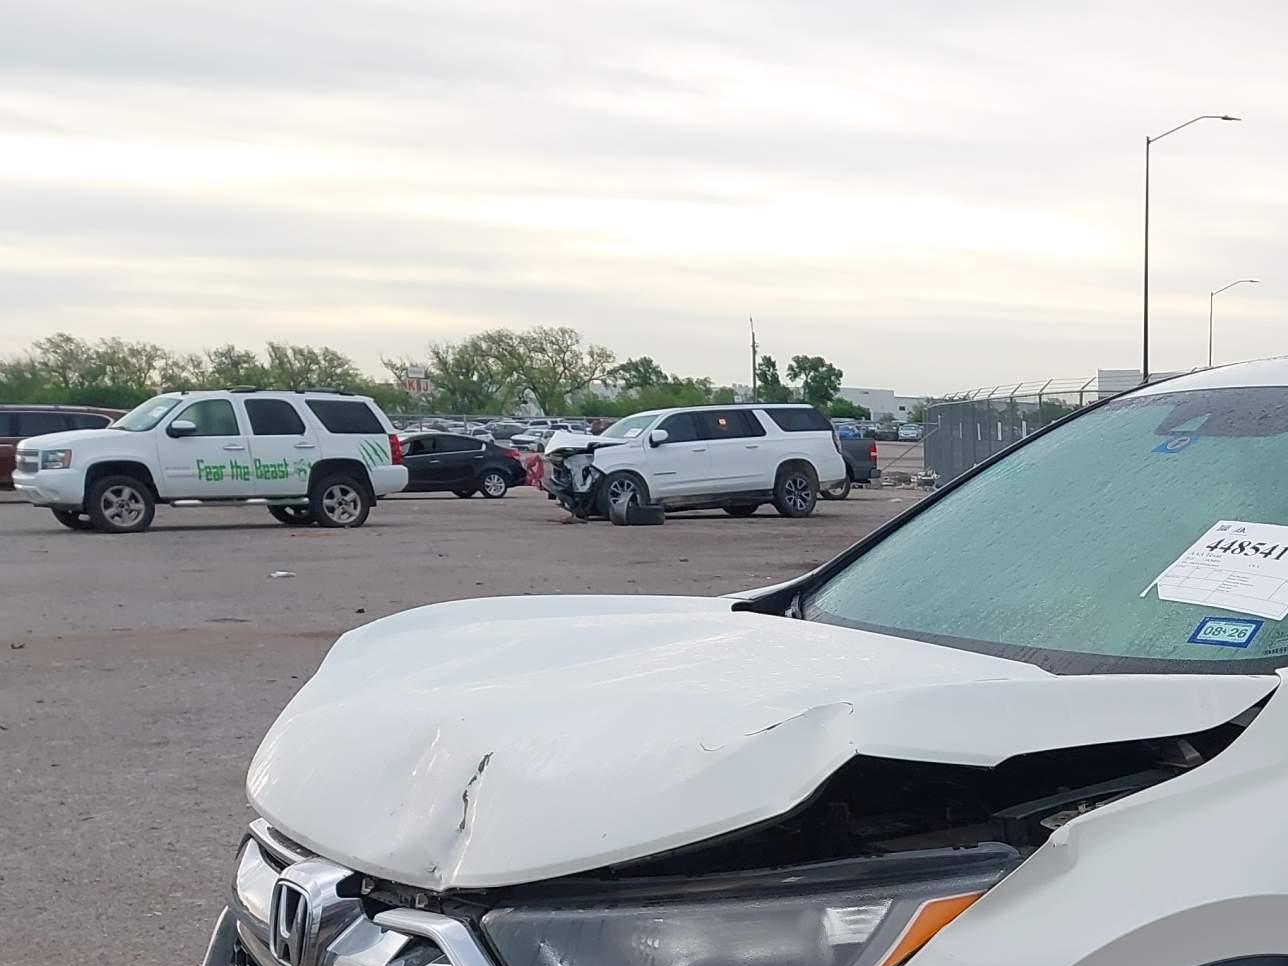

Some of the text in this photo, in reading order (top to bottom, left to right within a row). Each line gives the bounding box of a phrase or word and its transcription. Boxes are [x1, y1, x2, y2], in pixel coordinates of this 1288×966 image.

[196, 458, 289, 481] Fear the Beast
[1203, 625, 1223, 637] 08
[1227, 627, 1249, 639] 26
